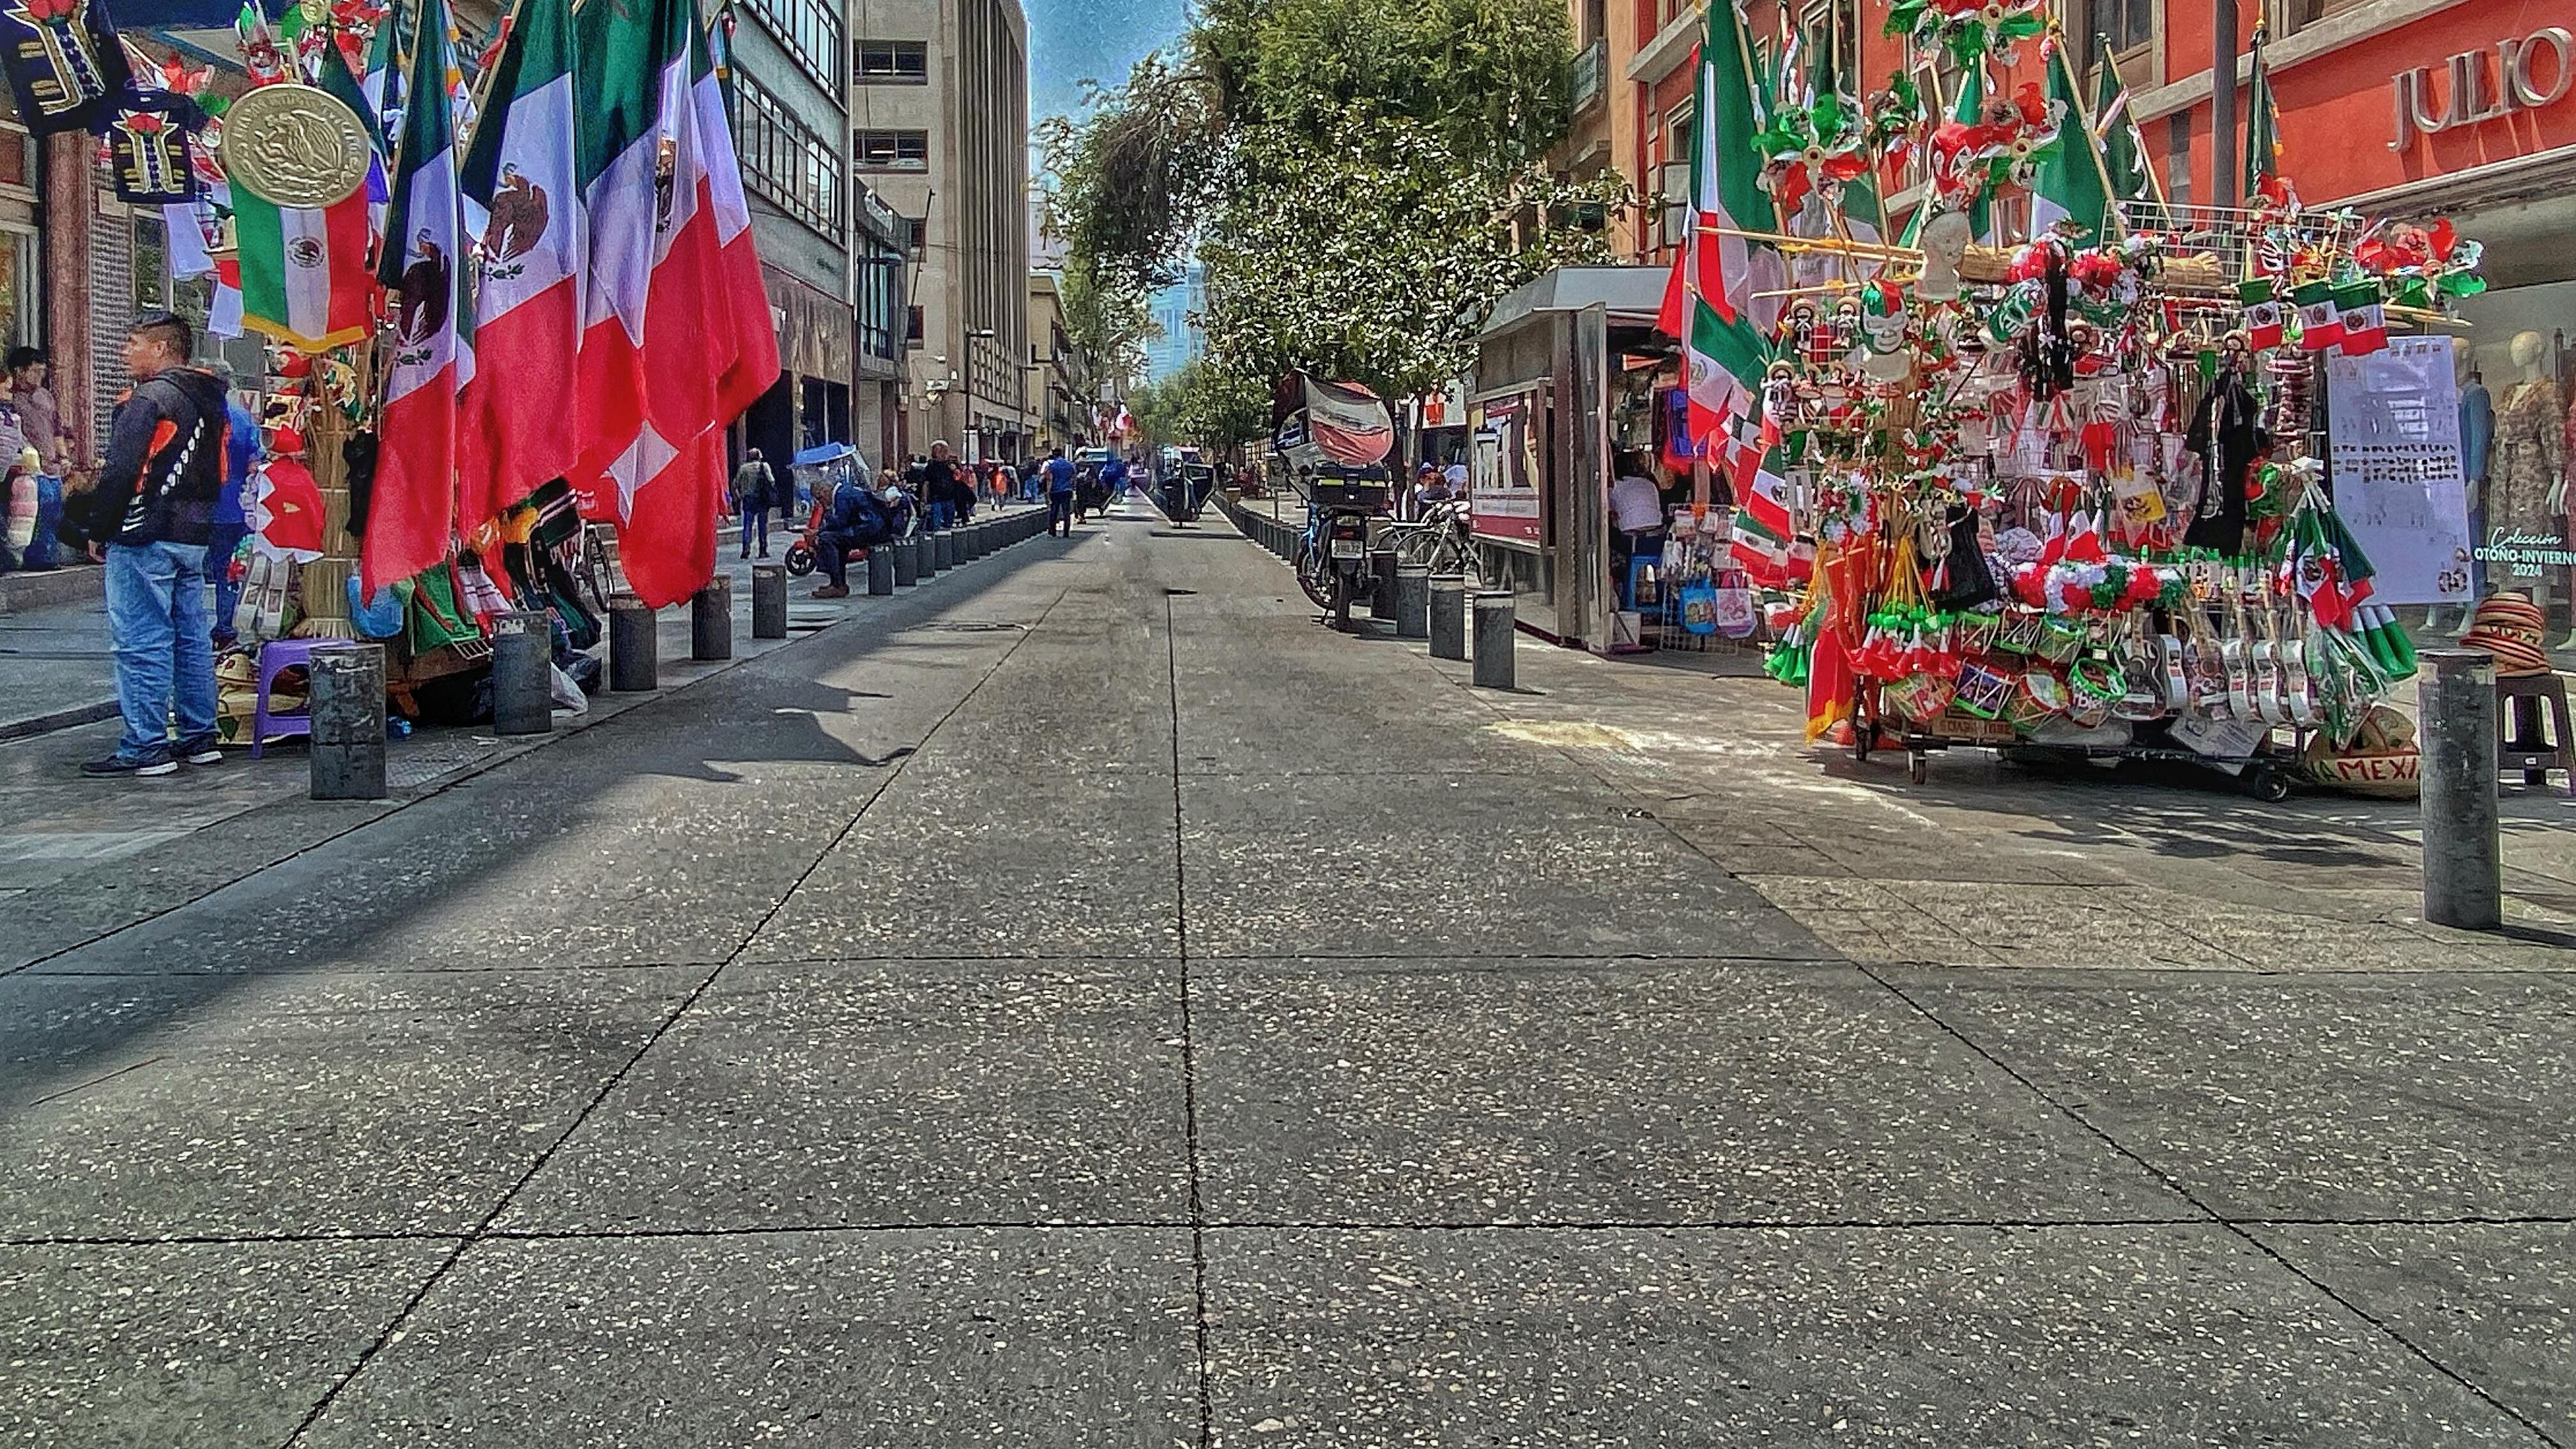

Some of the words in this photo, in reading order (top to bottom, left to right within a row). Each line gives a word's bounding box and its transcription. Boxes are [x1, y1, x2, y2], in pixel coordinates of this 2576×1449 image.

[2386, 26, 2573, 152] JULIO
[2512, 562, 2543, 577] 2024
[2336, 756, 2418, 781] MEXI
